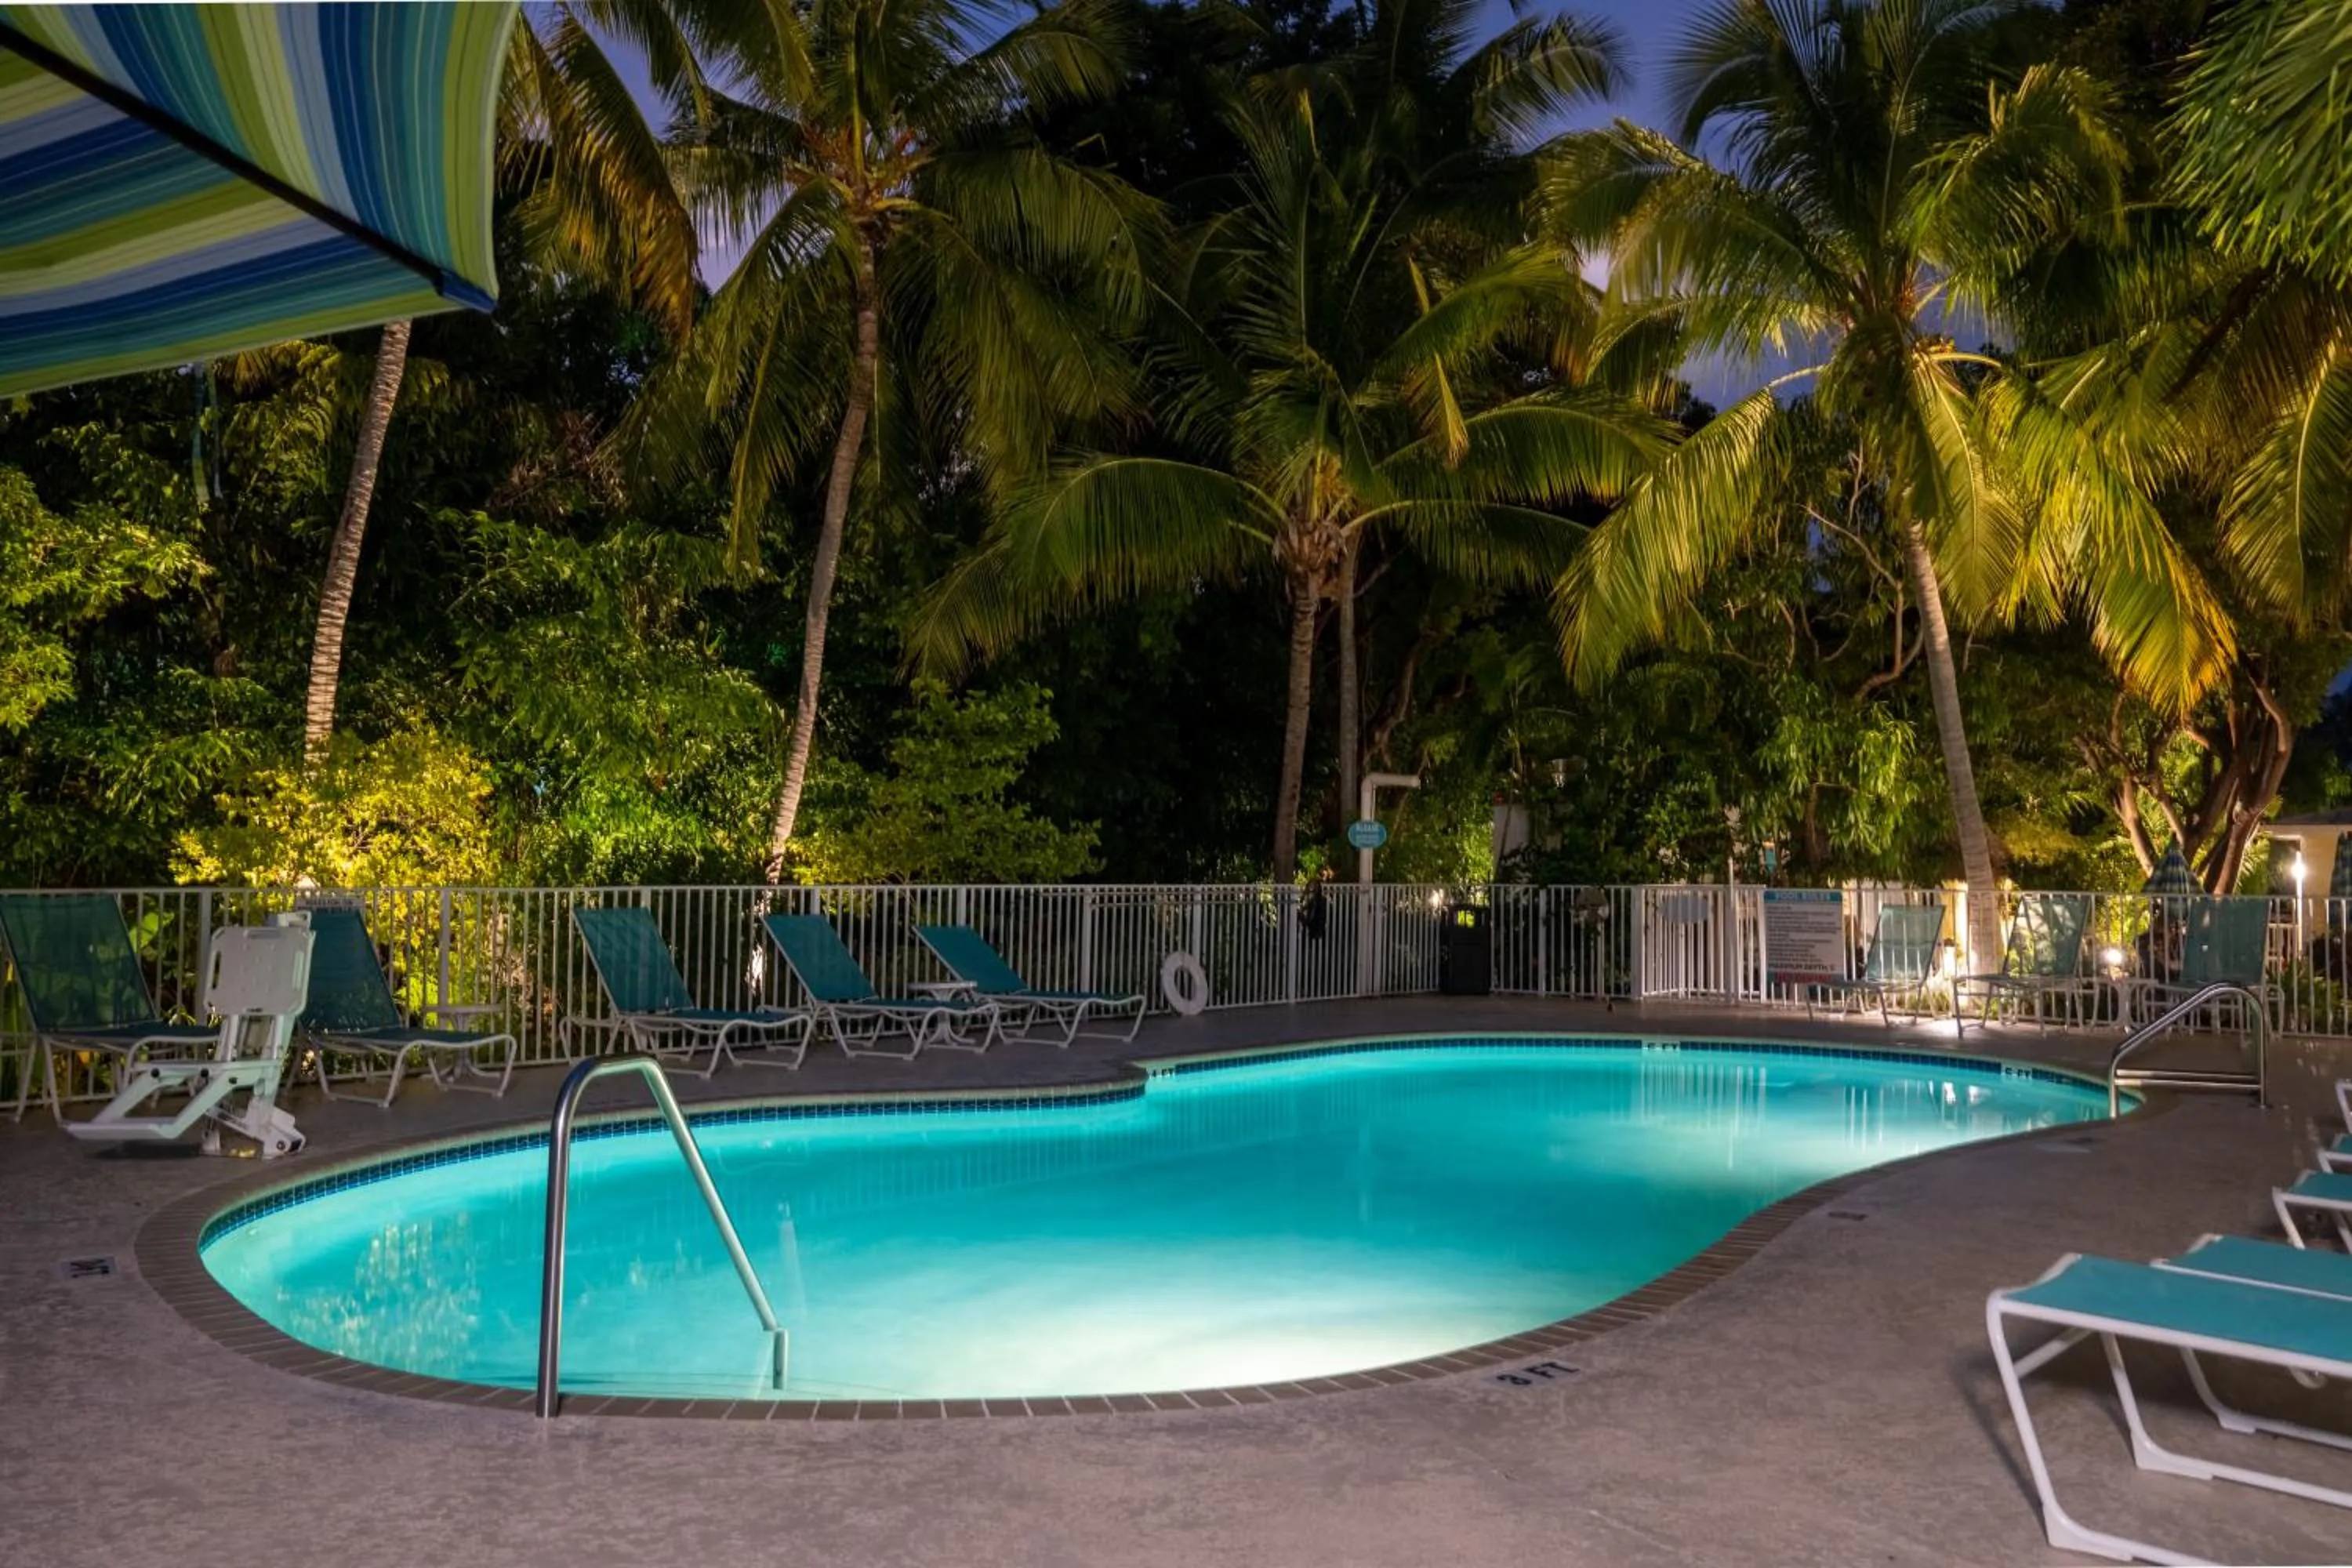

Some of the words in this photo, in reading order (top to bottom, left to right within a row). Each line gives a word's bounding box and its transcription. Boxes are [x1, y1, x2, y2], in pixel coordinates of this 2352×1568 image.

[1776, 892, 1798, 901] POOL
[1496, 1374, 1532, 1385] 3
[1523, 1362, 1581, 1379] FT
